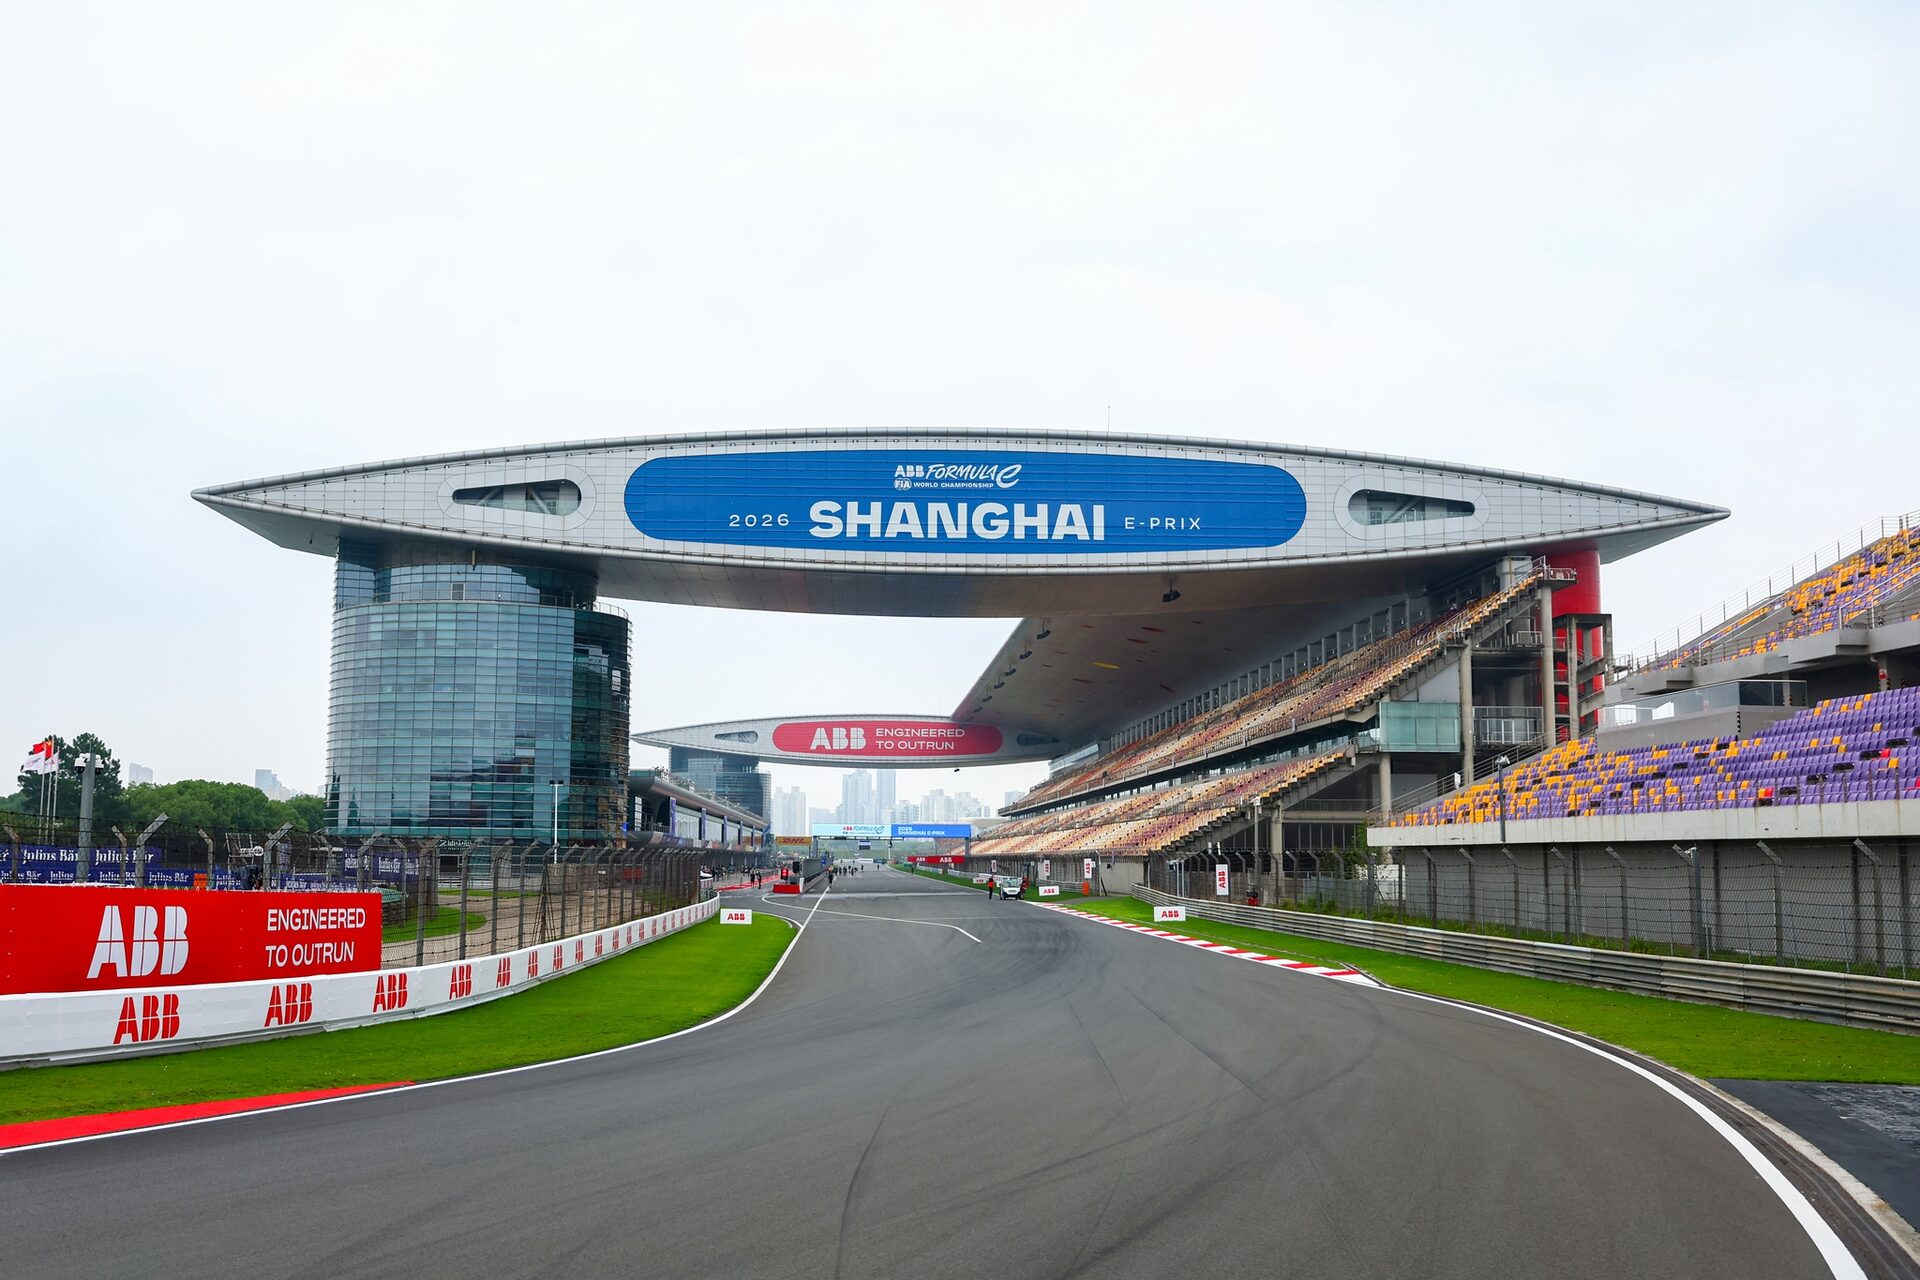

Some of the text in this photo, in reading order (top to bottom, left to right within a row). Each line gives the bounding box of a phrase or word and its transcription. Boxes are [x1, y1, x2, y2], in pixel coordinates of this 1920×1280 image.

[894, 465, 925, 477] ABB
[925, 464, 998, 480] FORMULA
[894, 479, 912, 490] FIA
[729, 500, 1202, 541] 2026 SHANGHAI E-PRIX
[810, 728, 965, 750] ABB ENGINEERED
[876, 741, 955, 750] TO OUTRUN
[22, 849, 57, 864] Julius
[100, 871, 121, 881] Juliu
[727, 913, 745, 921] ABB
[86, 905, 366, 979] ABB ENGINEERED
[265, 941, 355, 968] TO OUTRUN
[449, 964, 473, 1000] ABB
[496, 957, 511, 989] ABB
[264, 983, 313, 1027] ABB
[373, 972, 408, 1013] ABB
[113, 993, 180, 1045] ABB
